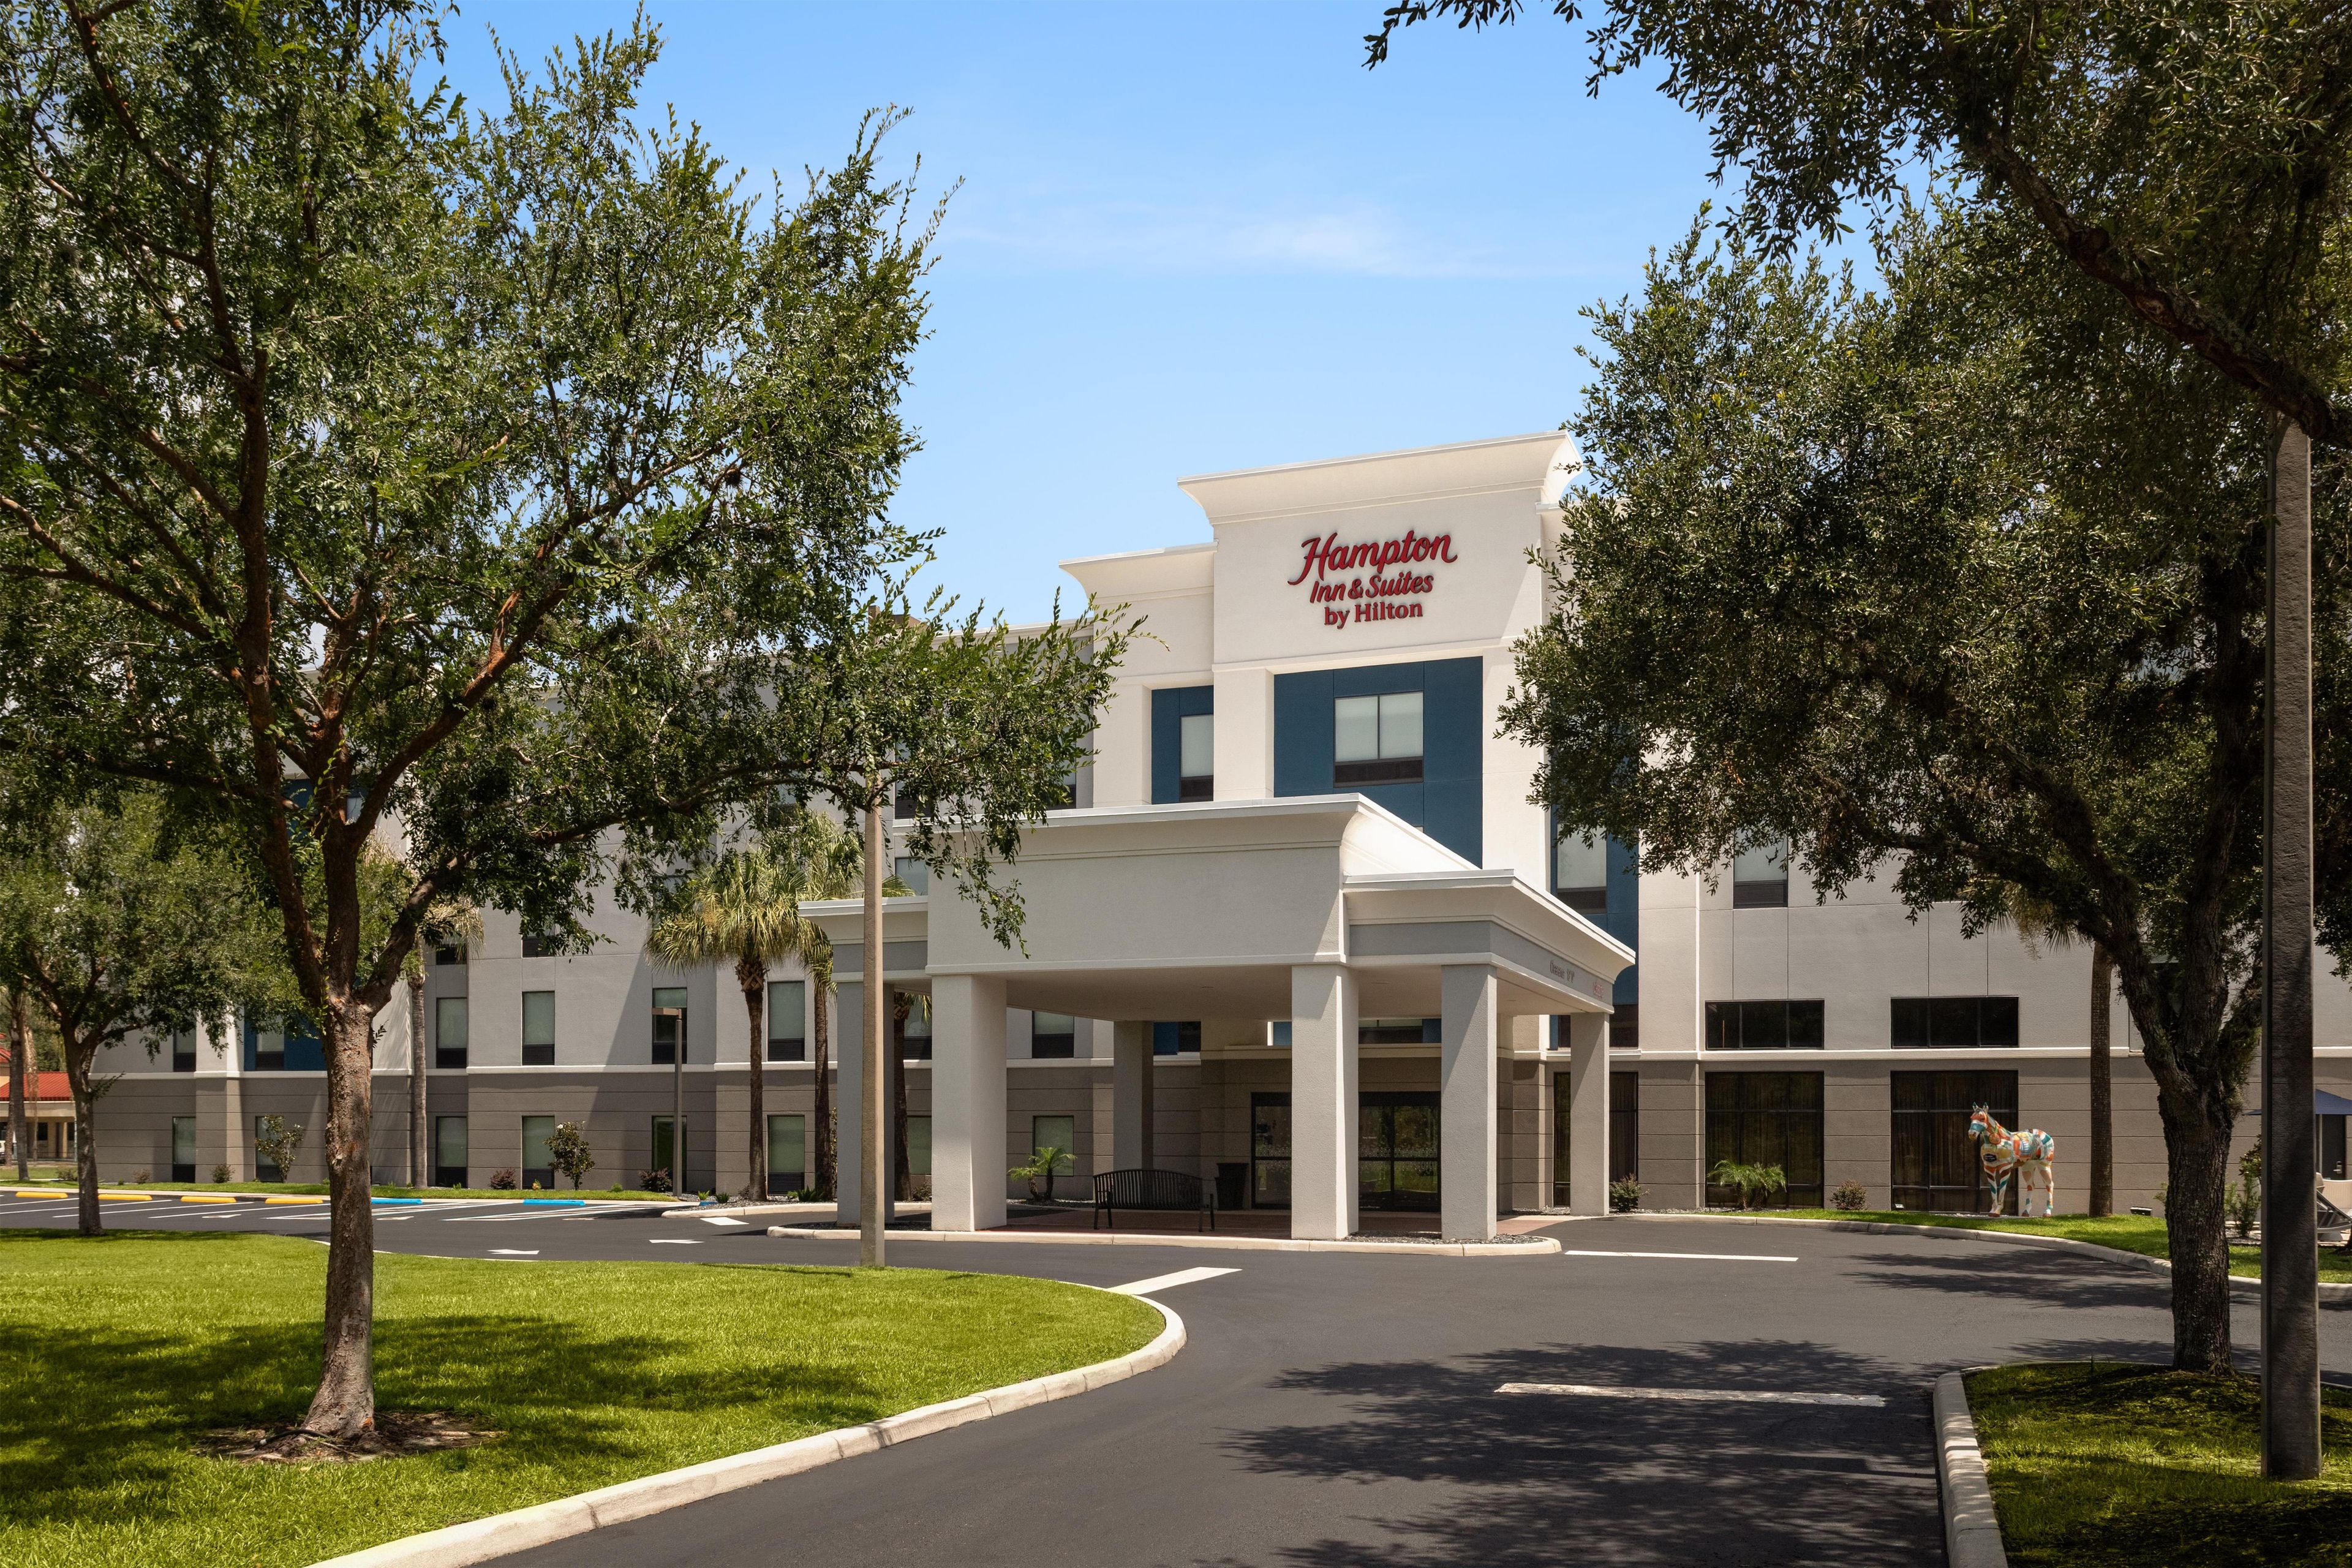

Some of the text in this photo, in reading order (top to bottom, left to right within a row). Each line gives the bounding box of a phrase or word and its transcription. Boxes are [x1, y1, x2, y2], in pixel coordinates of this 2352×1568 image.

[1287, 530, 1458, 586] Hampton
[1310, 571, 1434, 603] Inn & Suites
[1324, 601, 1423, 630] by Hilton
